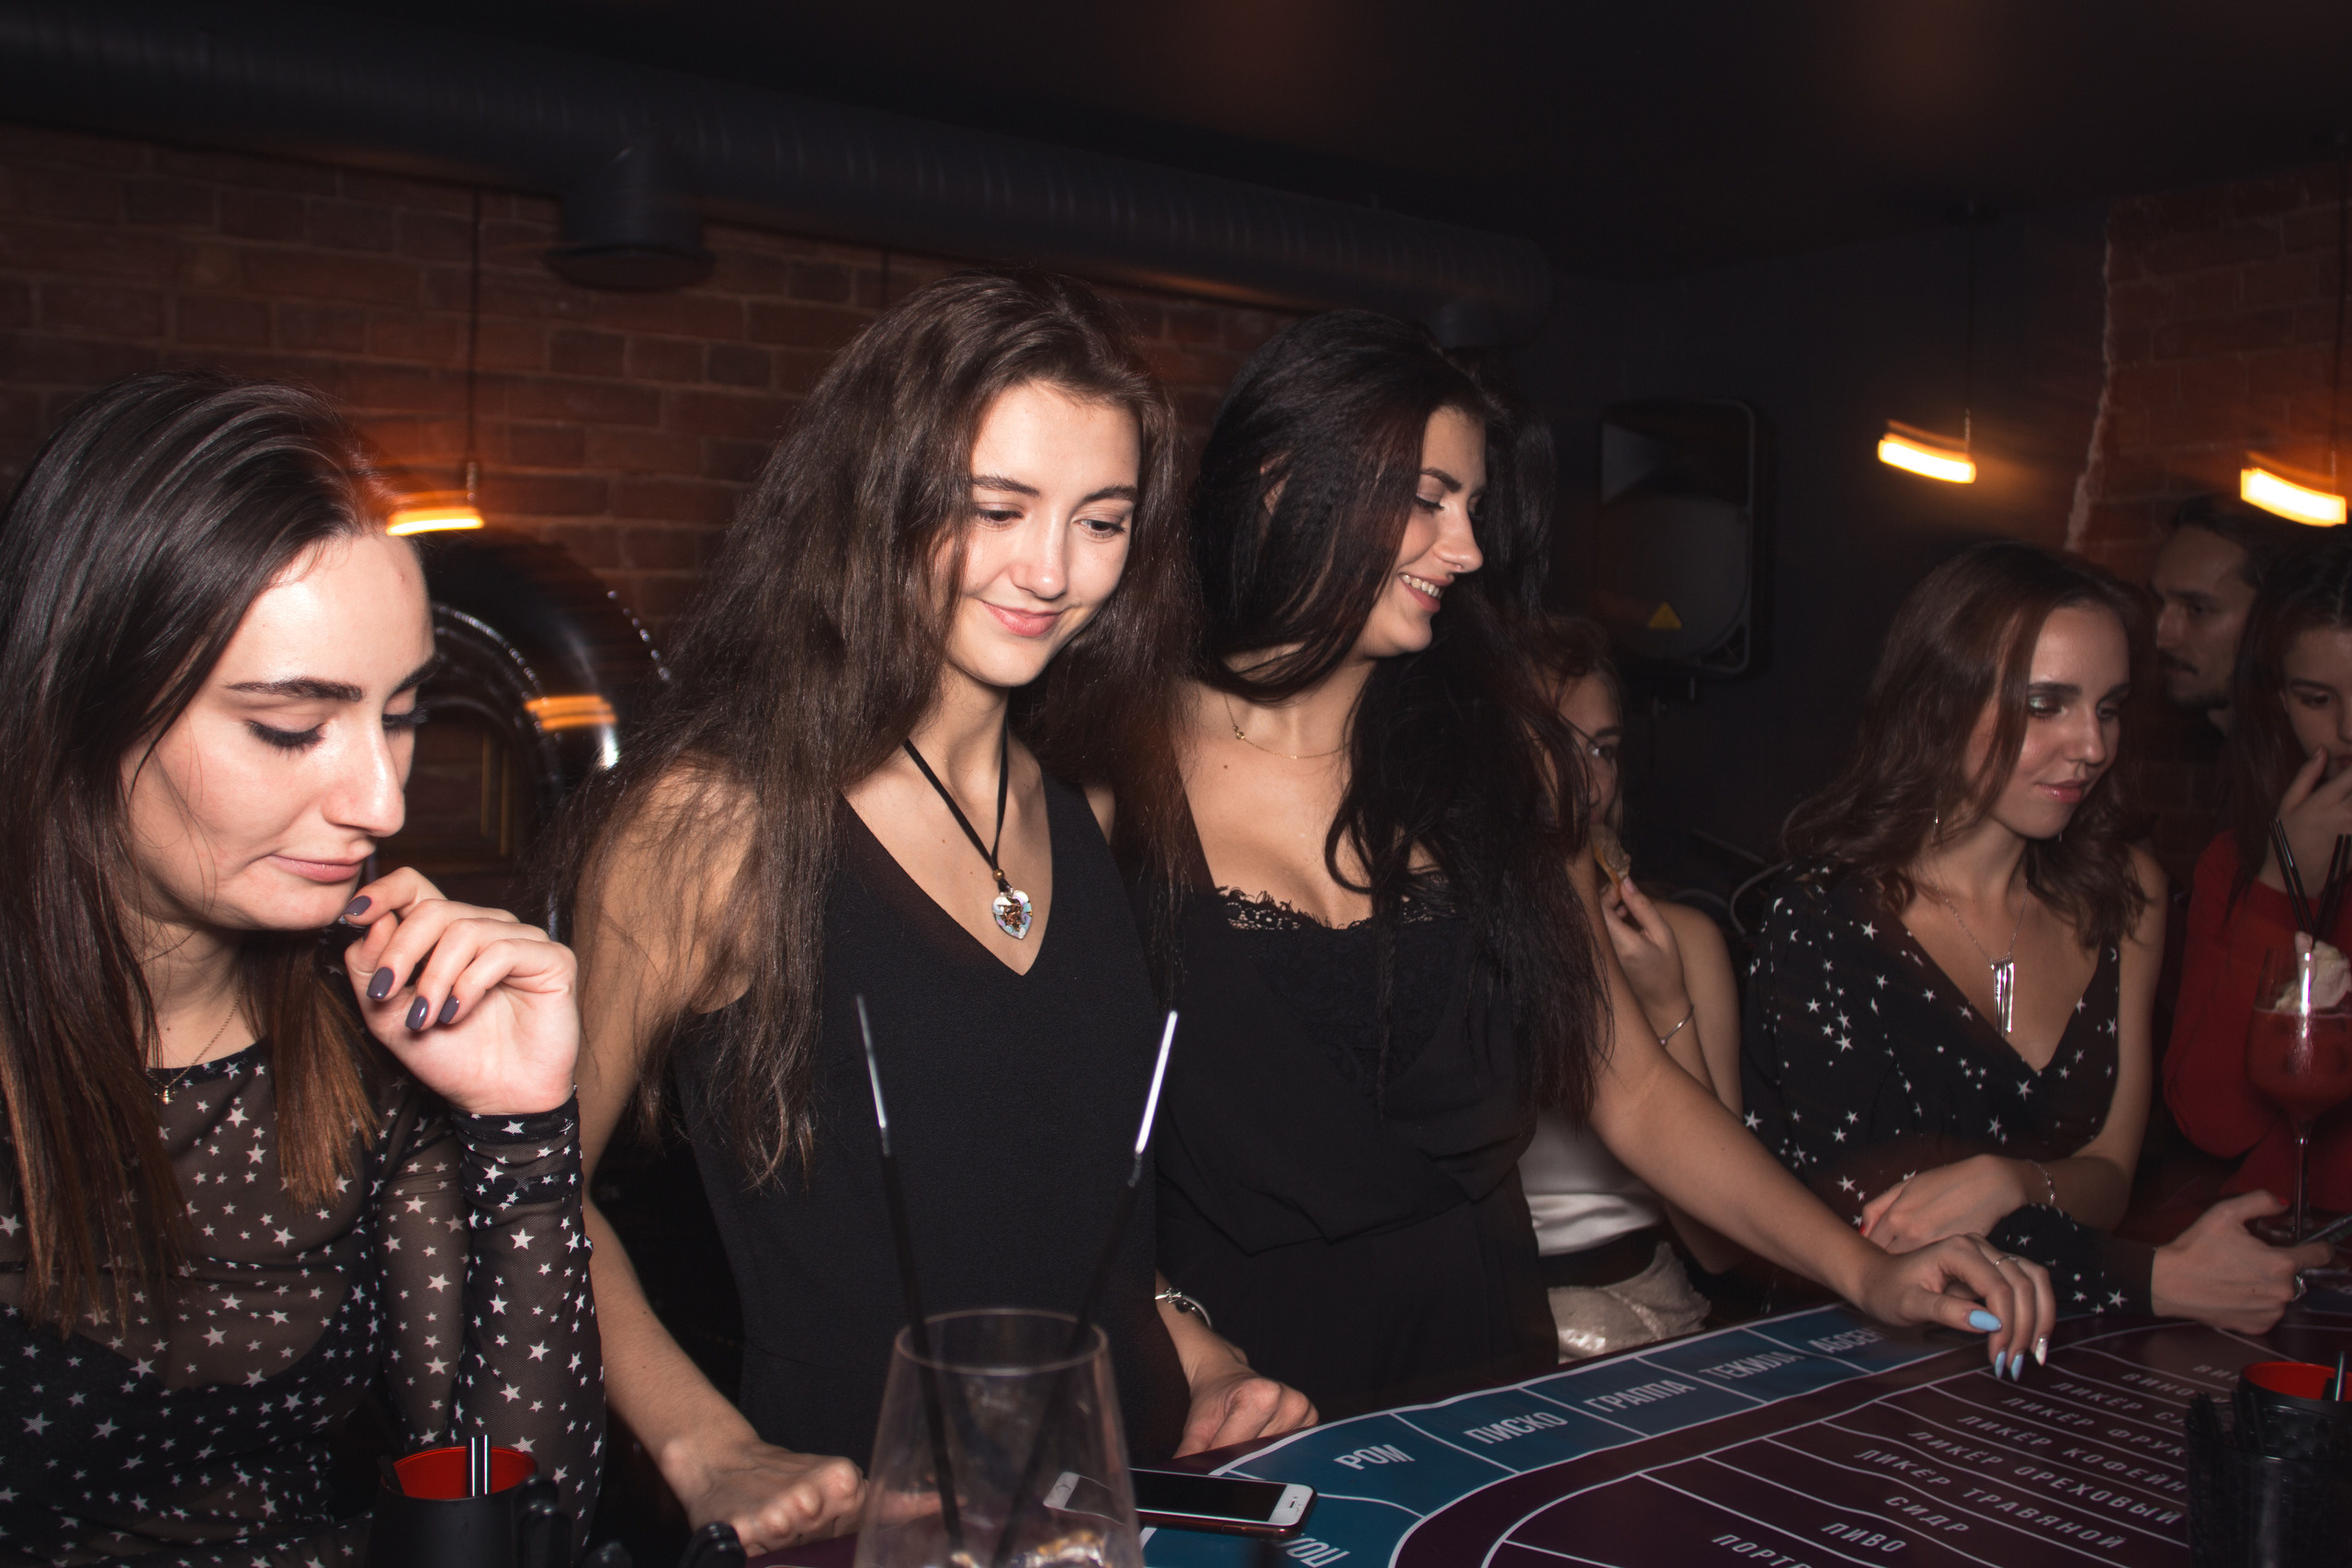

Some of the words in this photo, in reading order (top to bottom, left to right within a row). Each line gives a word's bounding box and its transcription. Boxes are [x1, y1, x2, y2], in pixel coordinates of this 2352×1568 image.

[1699, 1351, 1806, 1380] ТЕКИЛА
[1583, 1379, 1698, 1413] ГРАППА
[2050, 1382, 2143, 1411] ЛИКЁР
[2121, 1372, 2196, 1397] ВИНО
[1463, 1412, 1569, 1444] ПИСКО
[2001, 1397, 2095, 1426] ЛИКЁР
[2108, 1428, 2186, 1457] ФРУК
[1333, 1444, 1416, 1470] РОМ
[1956, 1415, 2052, 1446] ЛИКЁР
[2062, 1447, 2187, 1493] КОФЕЙН
[1907, 1431, 2005, 1465] ЛИКЁР
[2014, 1466, 2184, 1525] ОРЕХОВЫЙ
[1884, 1495, 1970, 1534] СИДР
[1962, 1487, 2128, 1548] ТРАВЯНОЙ
[1820, 1522, 1907, 1552] ПИВО
